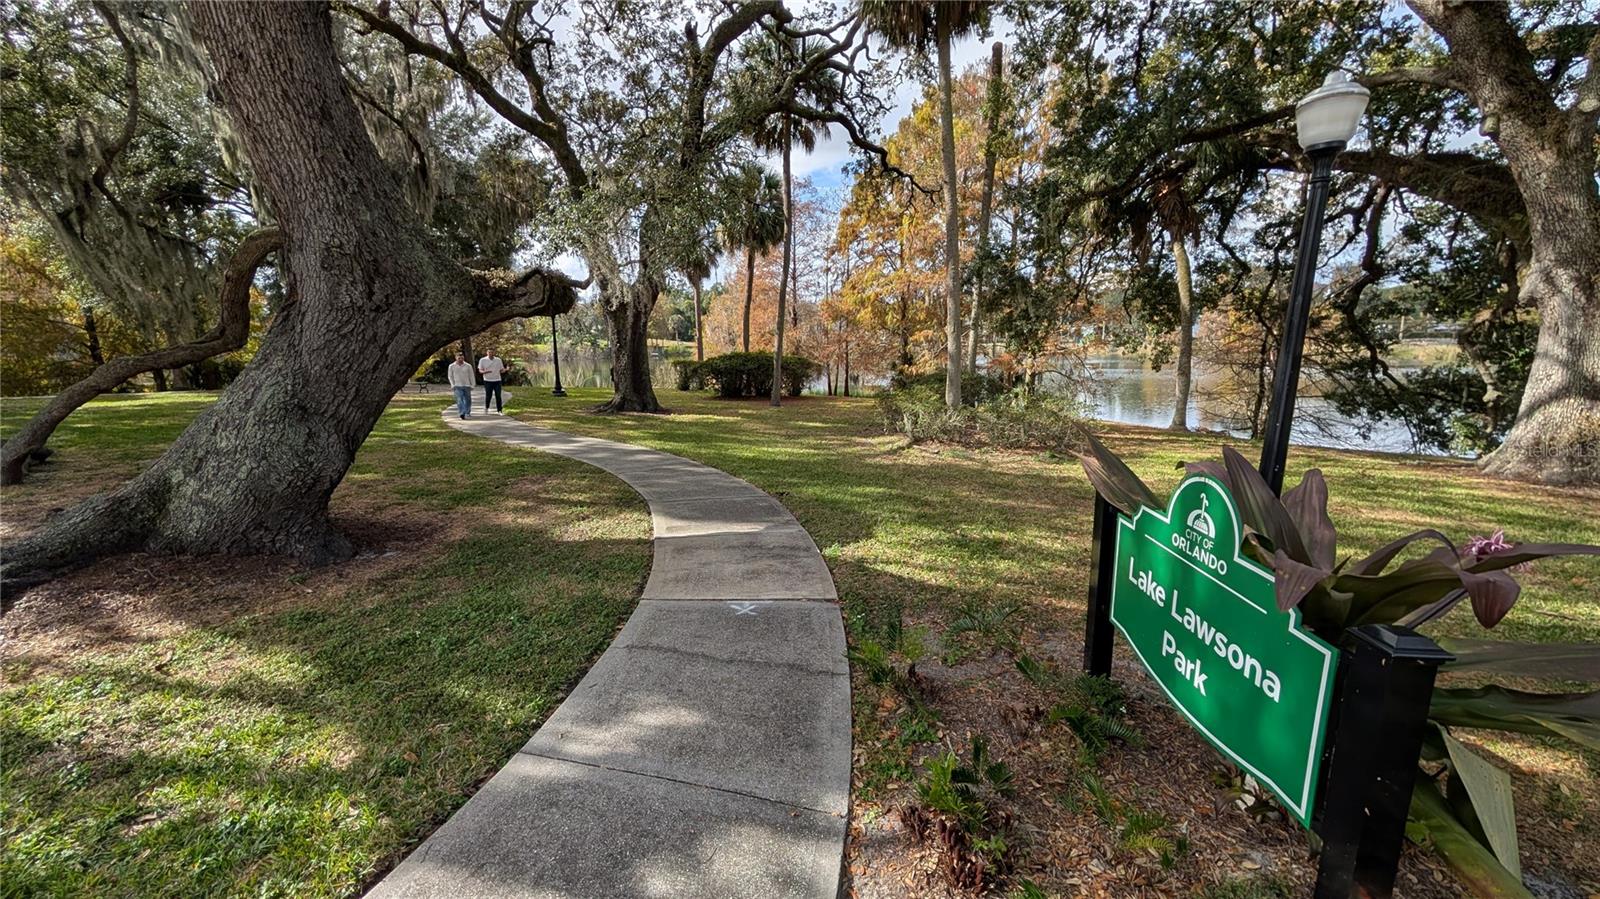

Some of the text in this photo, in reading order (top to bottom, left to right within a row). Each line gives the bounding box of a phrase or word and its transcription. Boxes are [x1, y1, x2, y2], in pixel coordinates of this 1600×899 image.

[1171, 533, 1228, 576] ORLANDO
[1185, 528, 1215, 550] CITY OF
[1128, 556, 1282, 704] Lake Lawsona
[1161, 629, 1209, 697] Park
